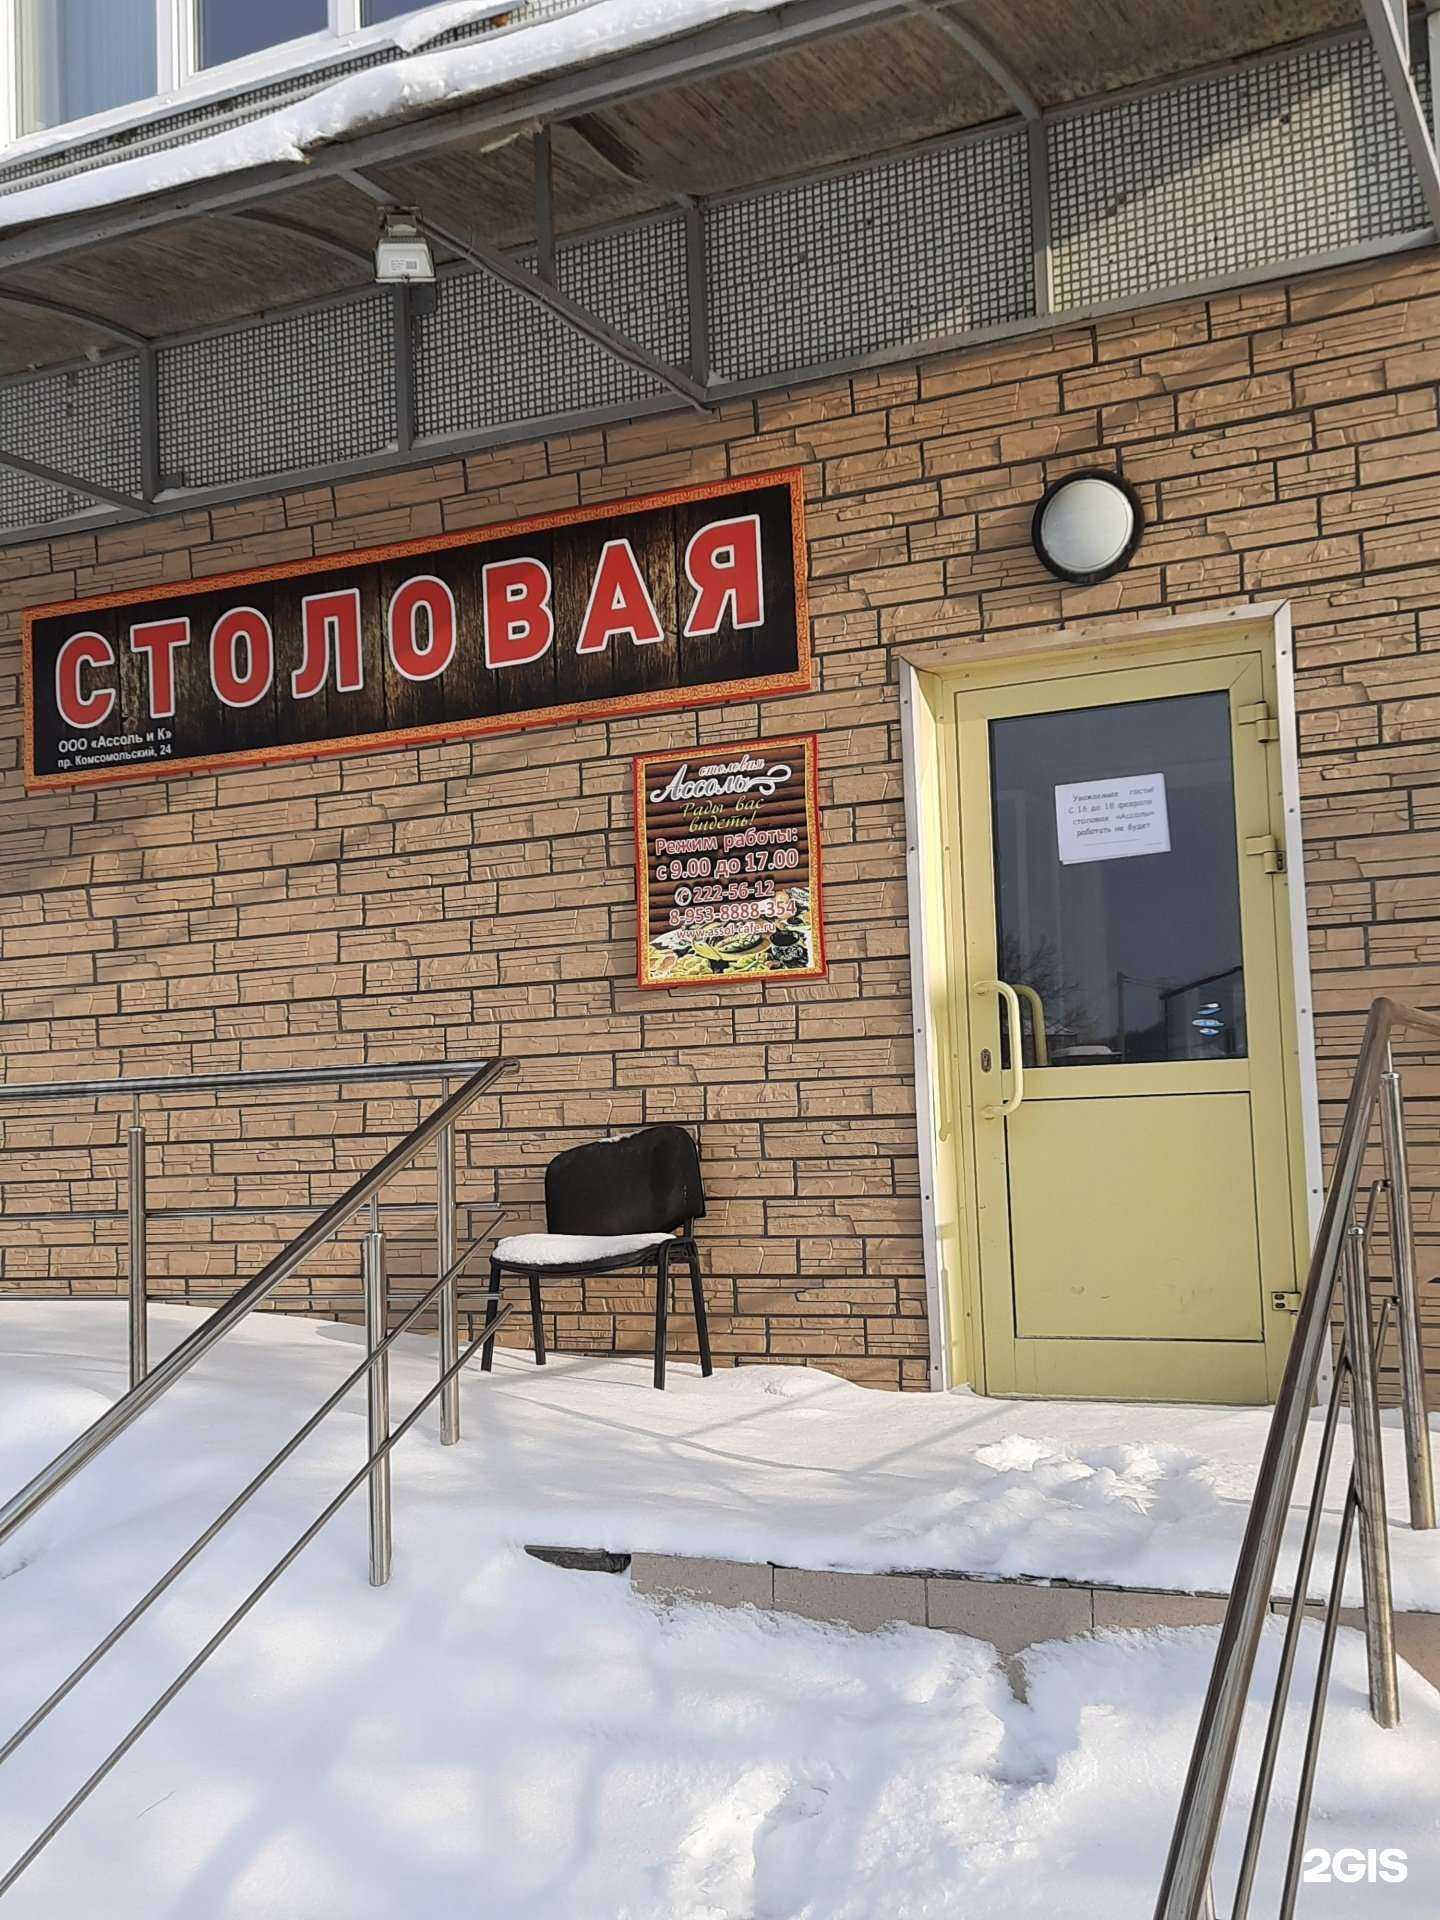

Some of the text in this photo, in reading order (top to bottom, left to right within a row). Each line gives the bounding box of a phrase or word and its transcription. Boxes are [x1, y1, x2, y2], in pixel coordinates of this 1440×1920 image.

[55, 514, 765, 729] СТОЛОВАЯ
[58, 727, 172, 753] ООО «Ассоль и К»
[58, 743, 172, 770] пр. Комсомольский, 24
[698, 754, 766, 777] столовая
[650, 763, 792, 803] Ассоль
[680, 795, 768, 818] Рады вас
[689, 811, 757, 833] видеть!
[1076, 826, 1112, 838] работать
[1114, 825, 1124, 833] не
[655, 827, 799, 856] Режим работы:
[656, 848, 800, 881] с 9.00 до 17.00
[692, 880, 776, 904] 222-56-12
[669, 900, 797, 926] 8-953-8888-354
